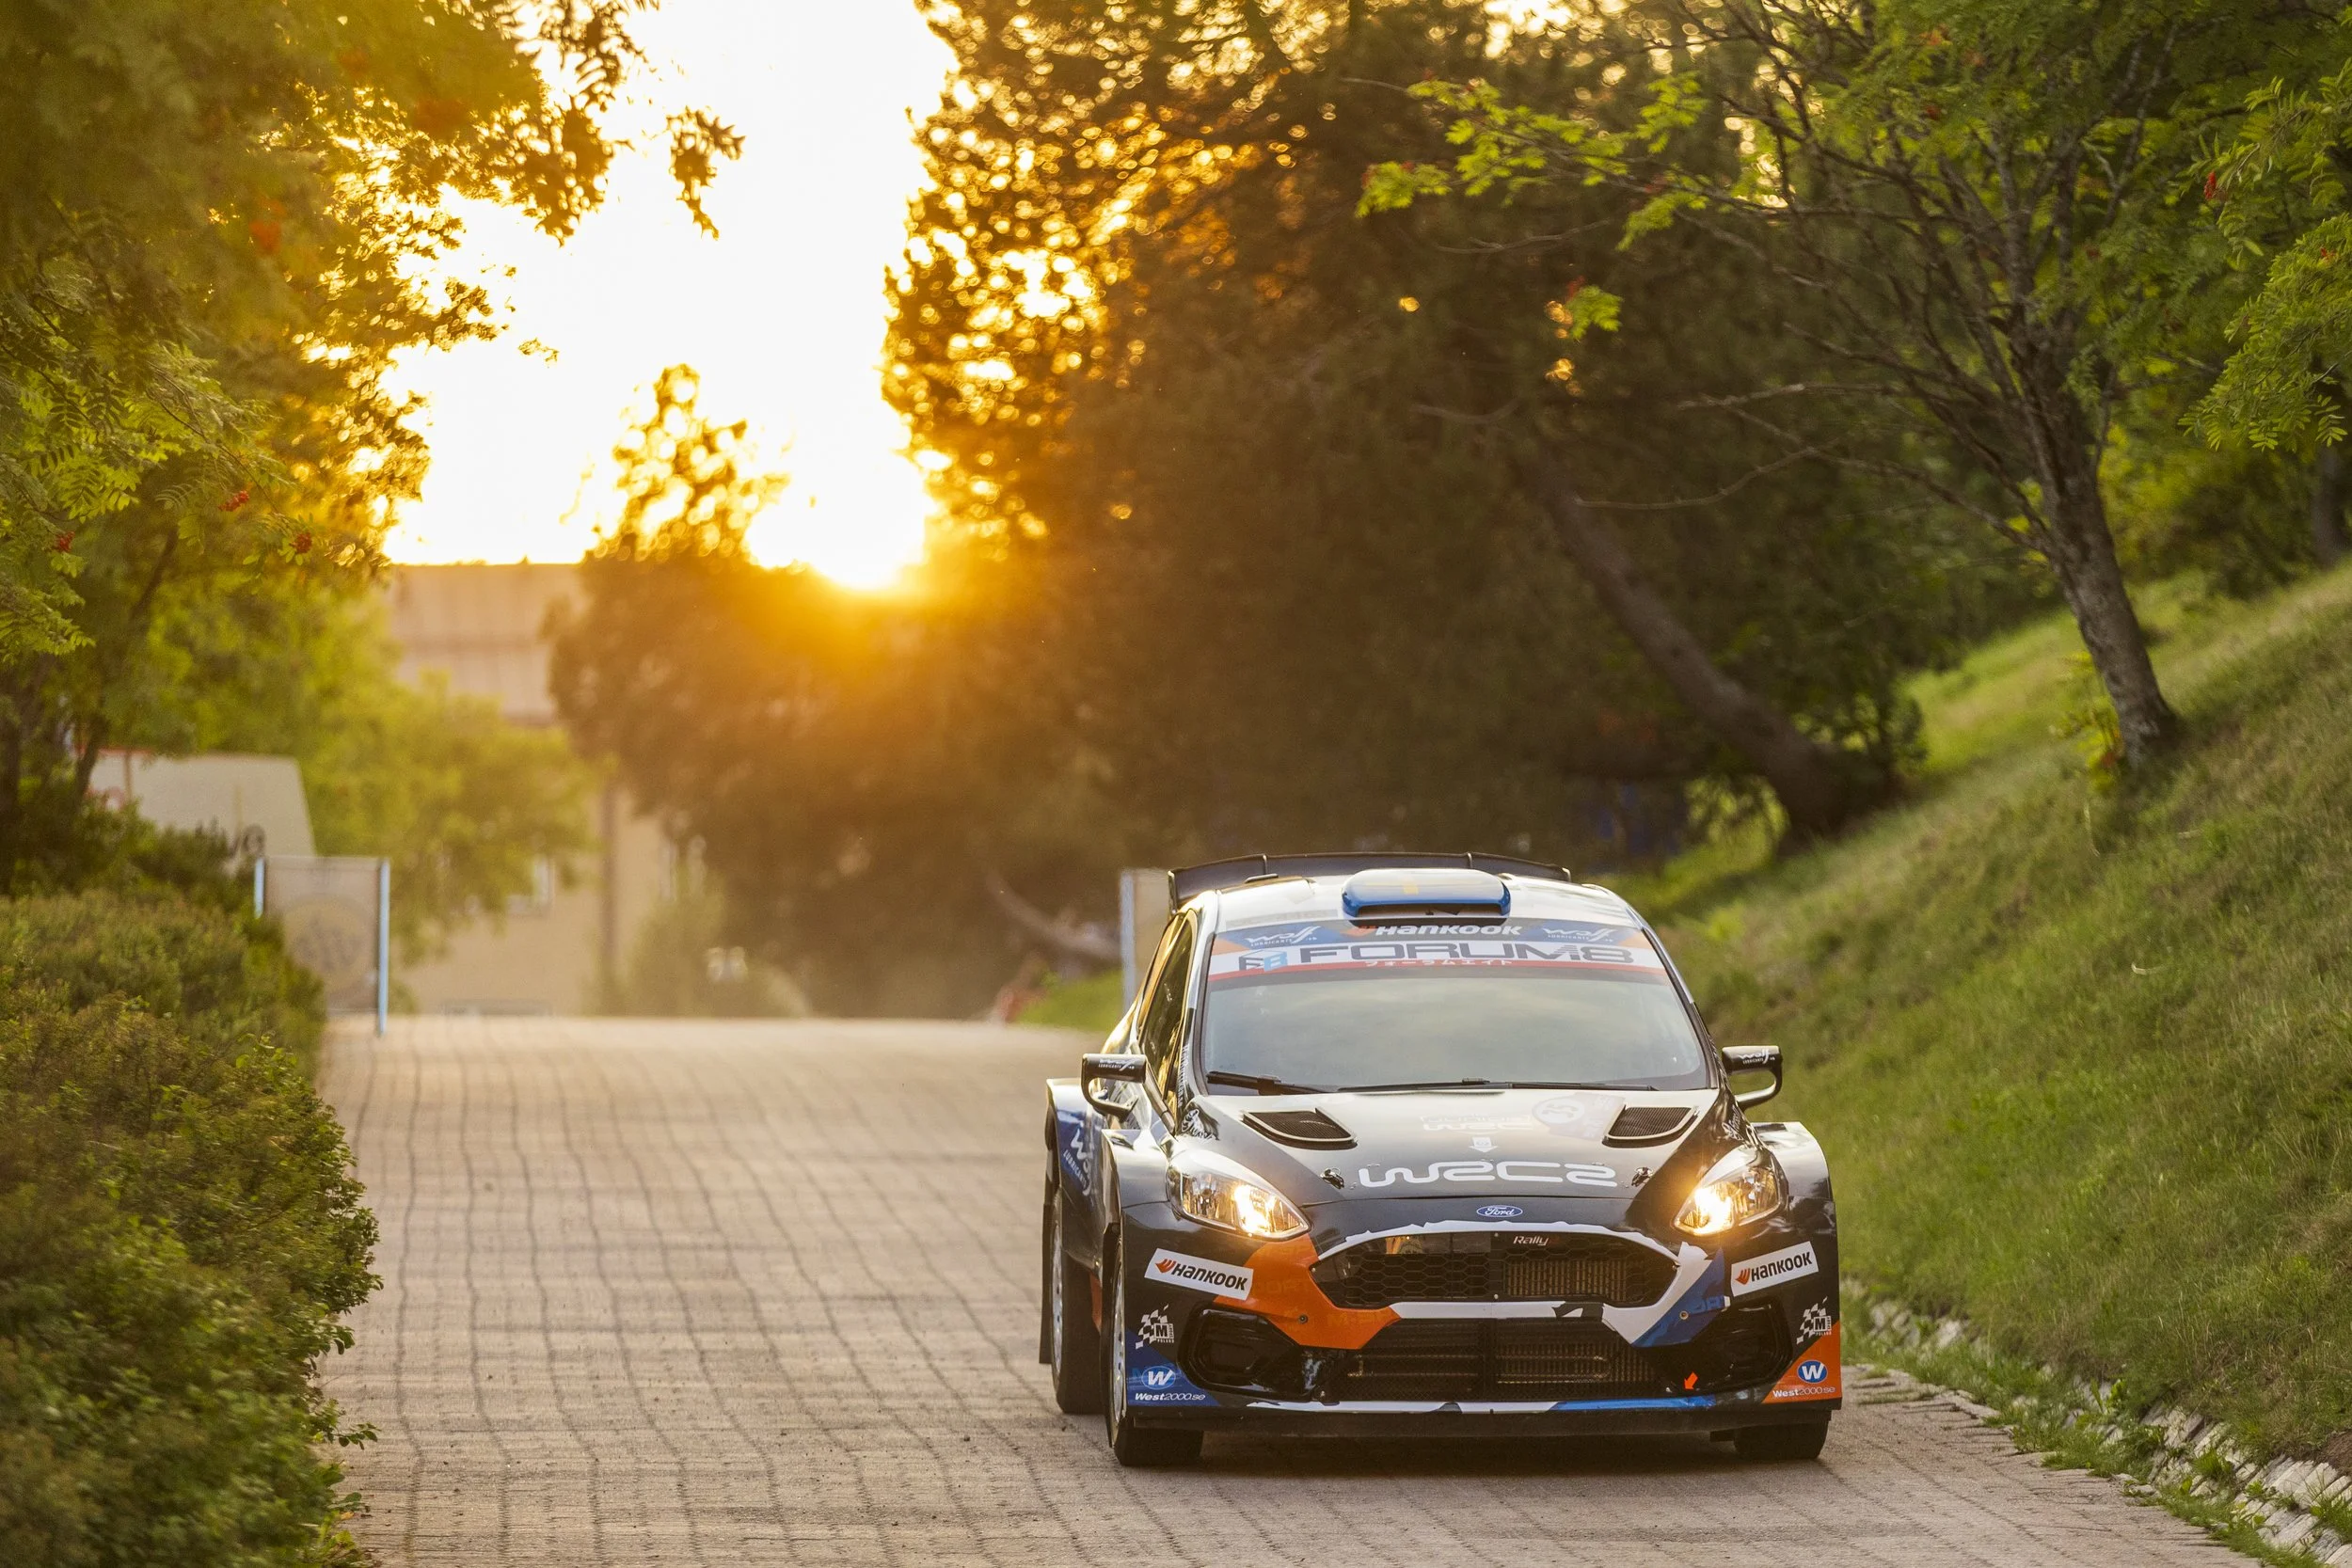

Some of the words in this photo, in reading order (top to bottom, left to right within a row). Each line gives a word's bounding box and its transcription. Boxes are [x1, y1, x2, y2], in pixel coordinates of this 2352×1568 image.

[1300, 942, 1634, 963] FORUM8
[1359, 1161, 1617, 1187] WRC2
[1485, 1207, 1515, 1215] Ford
[1155, 1324, 1168, 1337] M
[1814, 1318, 1826, 1330] M
[1148, 1370, 1173, 1386] W
[1801, 1363, 1825, 1380] W
[1135, 1392, 1206, 1401] West2000.se
